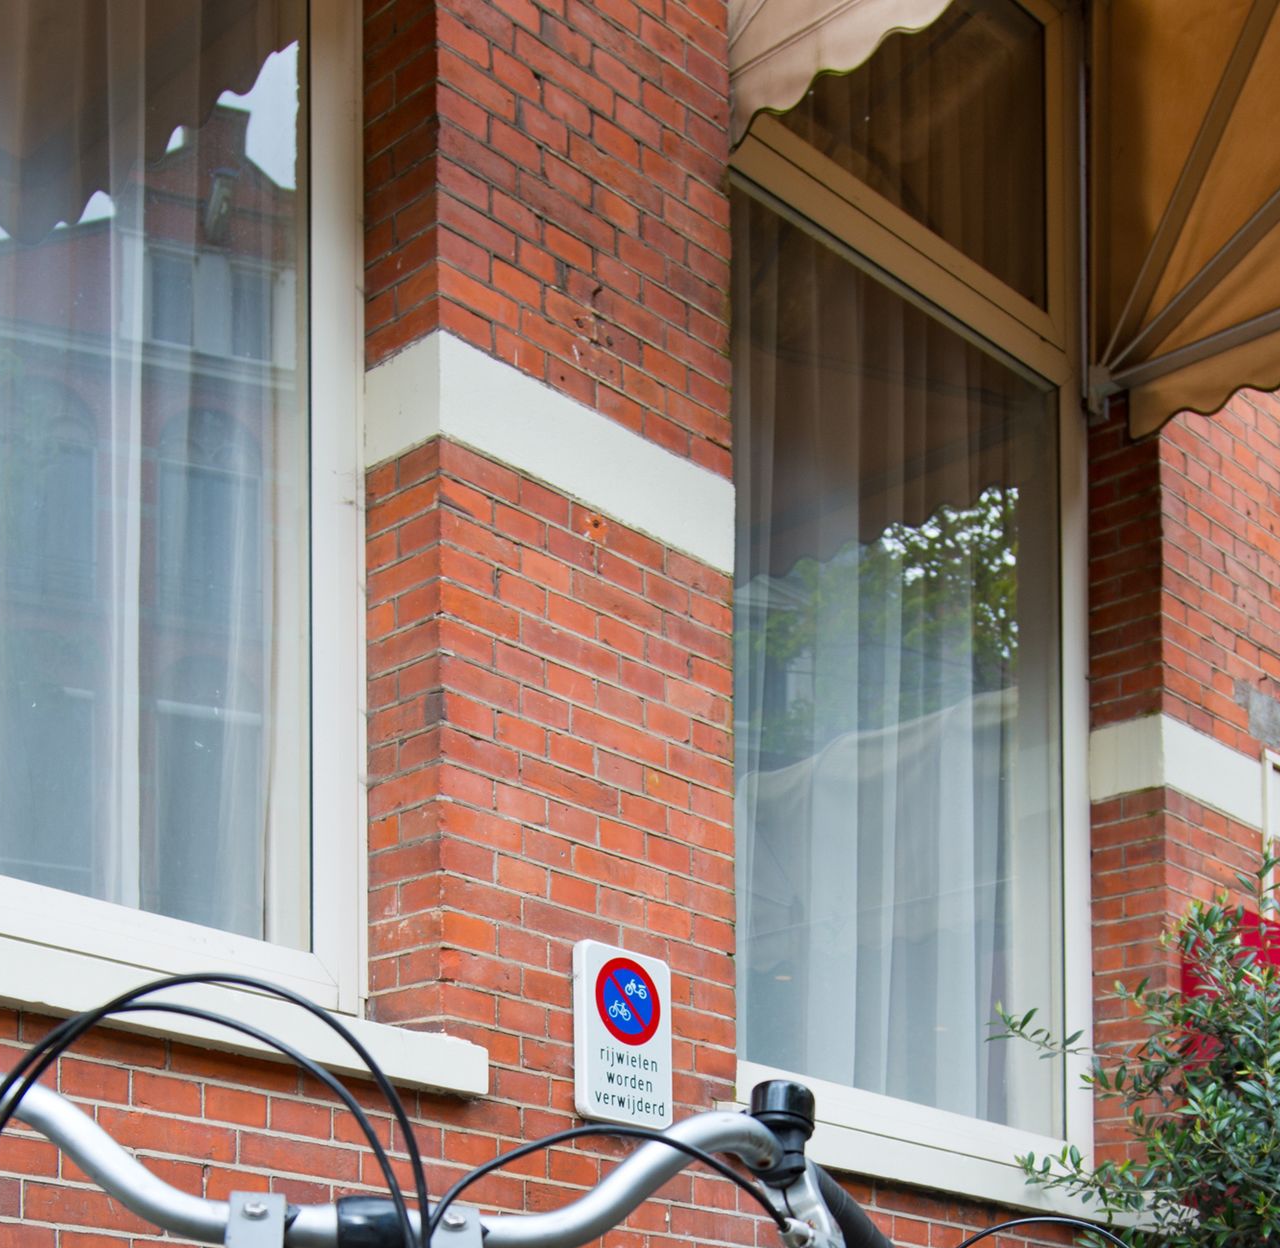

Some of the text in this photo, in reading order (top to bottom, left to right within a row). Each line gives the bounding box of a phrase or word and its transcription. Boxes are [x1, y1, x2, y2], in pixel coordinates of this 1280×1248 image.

[600, 1047, 658, 1072] rijwielen
[606, 1071, 653, 1093] worden
[595, 1090, 665, 1117] verwijderd
